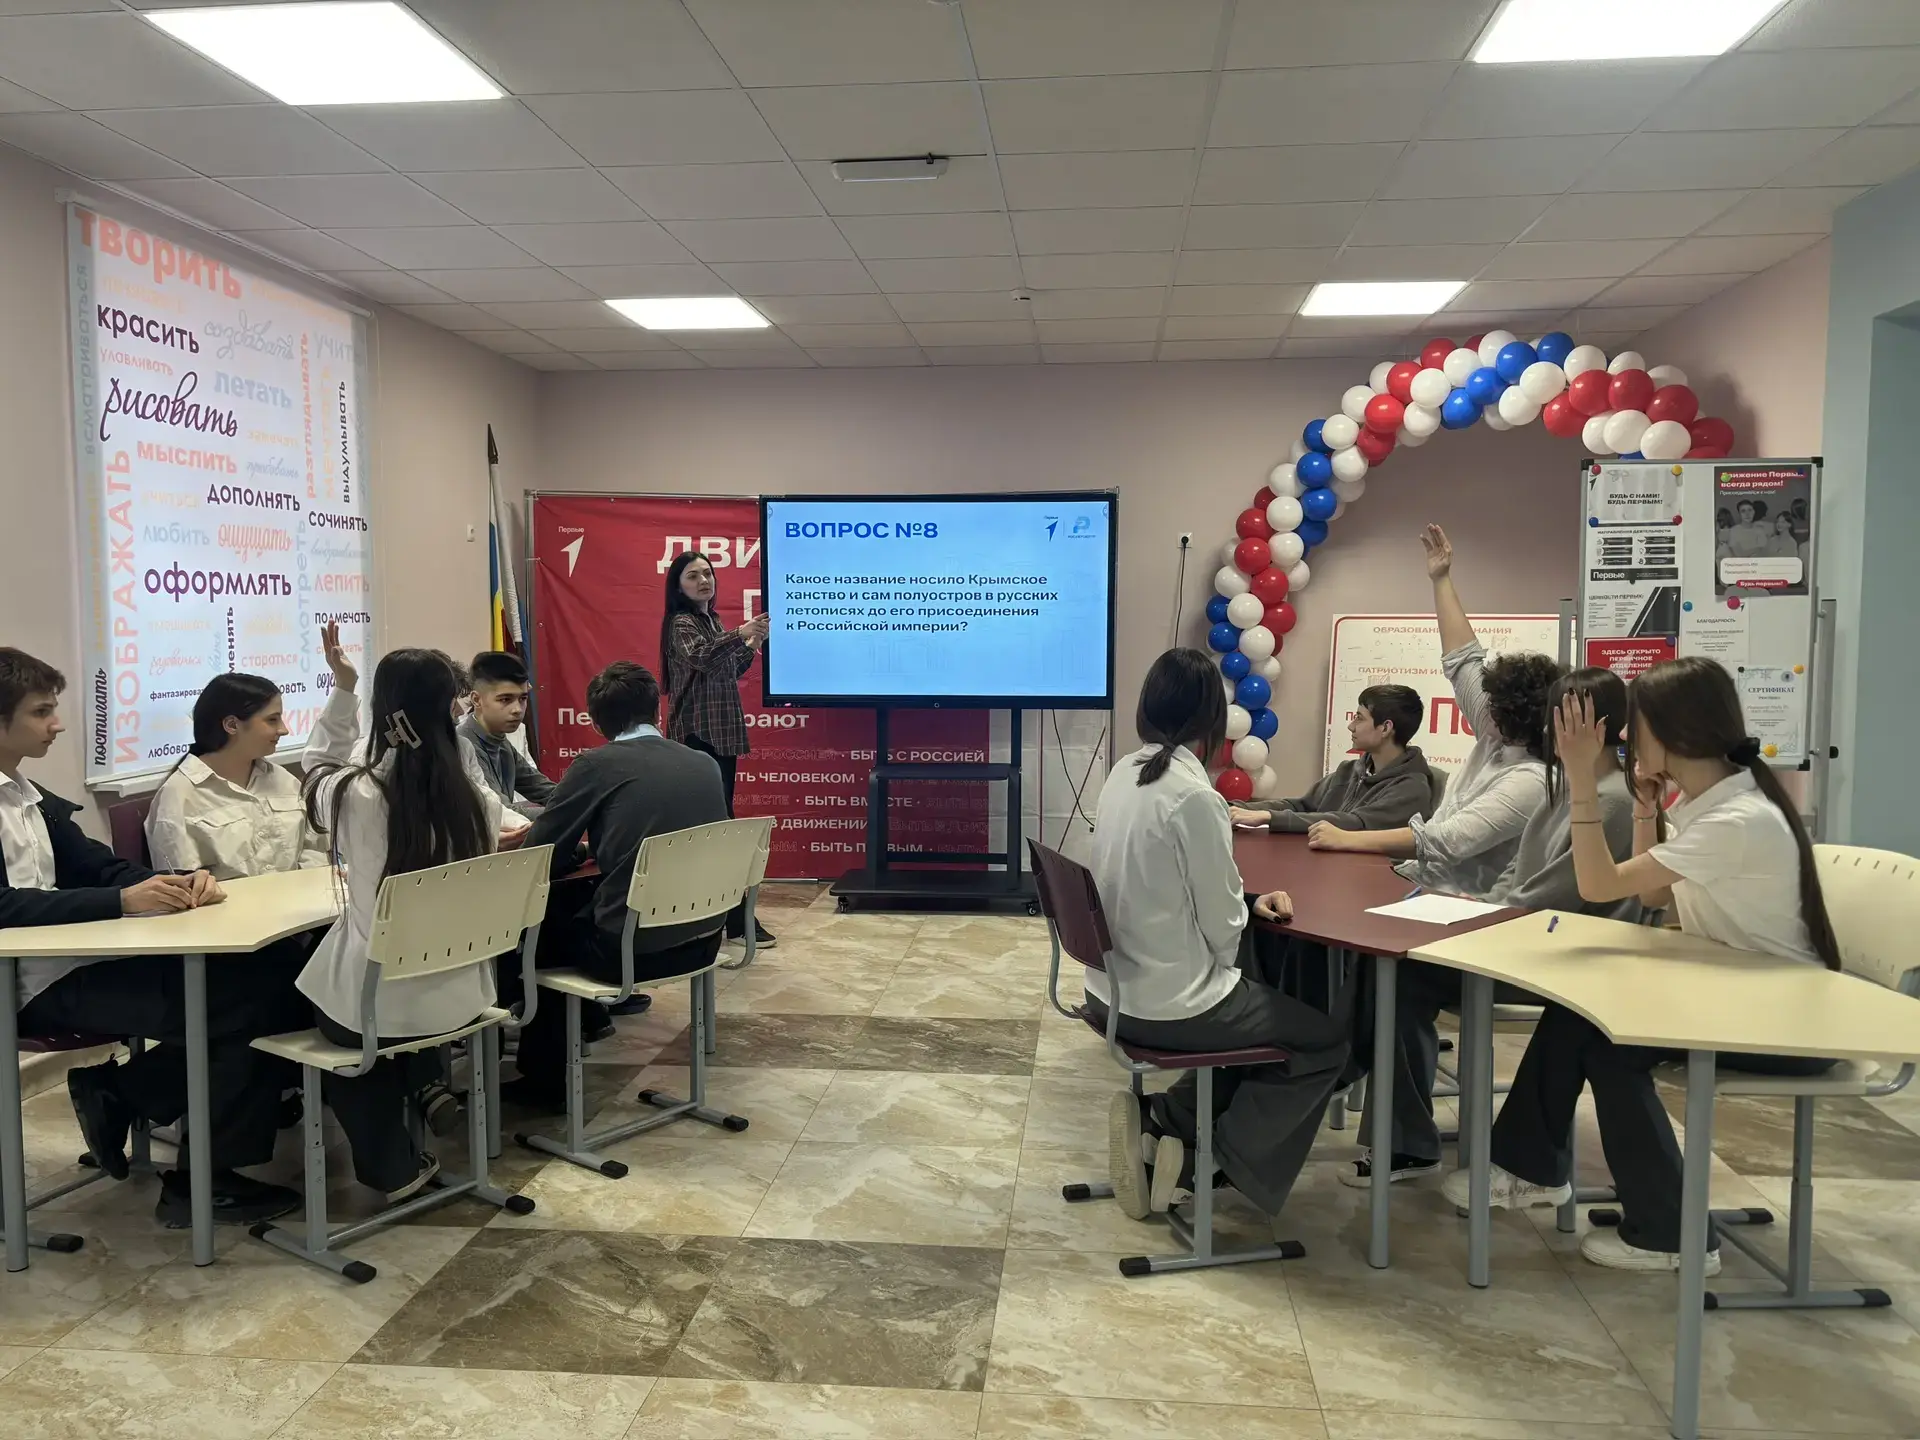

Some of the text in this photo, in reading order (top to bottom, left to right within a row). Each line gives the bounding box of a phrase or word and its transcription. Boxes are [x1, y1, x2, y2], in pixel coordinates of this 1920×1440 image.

[74, 206, 242, 299] творить
[97, 304, 200, 353] красить
[100, 347, 173, 376] улавливать
[214, 371, 292, 409] летать
[100, 371, 238, 442] рисовать
[338, 381, 350, 503] выдумывать
[137, 440, 238, 474] мыслить
[207, 483, 300, 512] дополнять
[309, 511, 368, 531] сочинять
[785, 522, 938, 538] ВОПРОС №8
[143, 522, 210, 546] любить
[144, 561, 291, 603] оформлять
[314, 573, 370, 593] лепить
[785, 574, 1048, 586] Какое название носило Крымское
[1593, 571, 1625, 580] Первые
[295, 519, 311, 674] смотреть
[786, 591, 1058, 602] ханство и сам полуостров в русских
[106, 450, 142, 764] ИЗОБРАЖАТЬ
[786, 607, 1039, 618] летописях до его присоединения
[786, 620, 968, 633] к Российской империи?
[1373, 626, 1440, 634] ОБРАЗОВАН
[1358, 667, 1428, 675] ПАТРИОТИЗМ
[150, 688, 204, 700] фантазирова
[94, 667, 108, 766] постигать
[850, 750, 985, 762] БЫЬ С РОССИЕЙ
[759, 772, 855, 783] ЧЕЛОВЕКОМ
[805, 795, 913, 807] БЫТЬ ВМСТЕ
[810, 842, 853, 852] БЫТЬ
[856, 842, 923, 853] ПВЫМ
